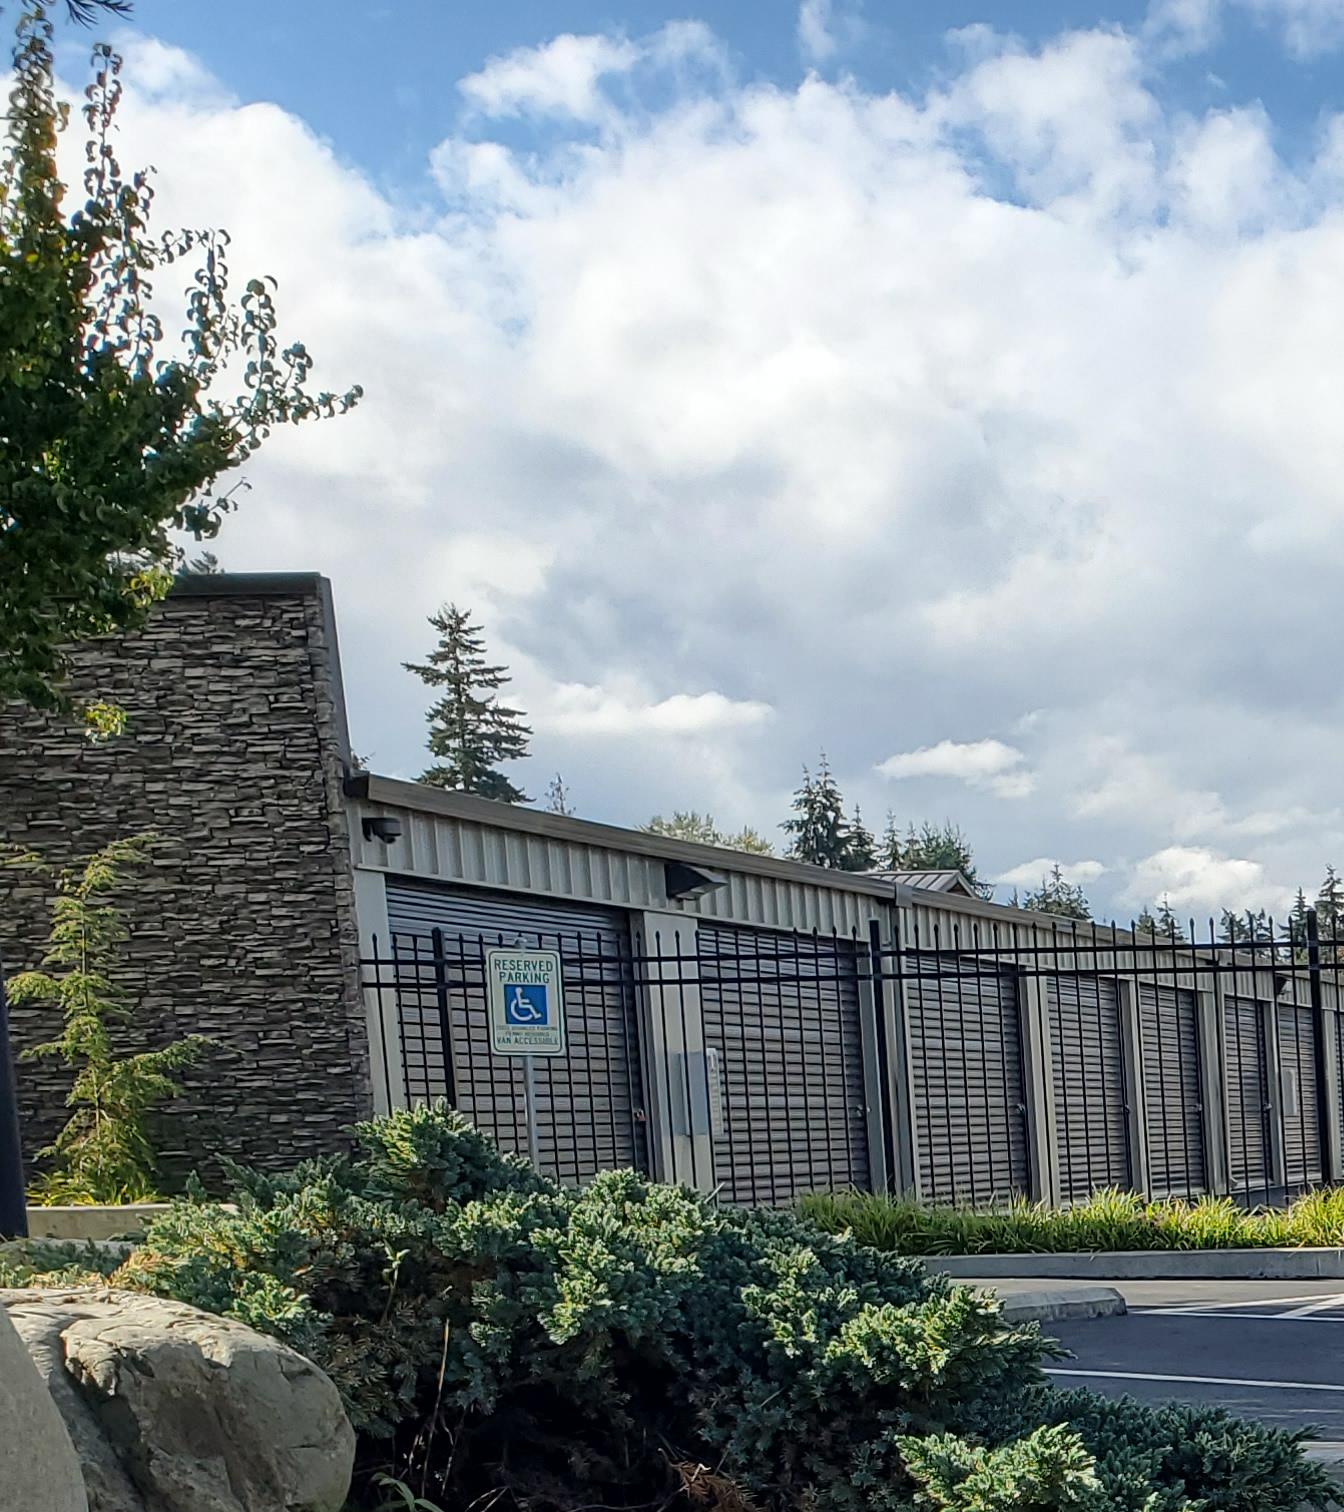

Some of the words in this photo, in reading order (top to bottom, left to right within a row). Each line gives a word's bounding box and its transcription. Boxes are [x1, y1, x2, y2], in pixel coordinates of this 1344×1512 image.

[494, 959, 554, 972] RESERVED
[499, 972, 550, 984] PARKING
[497, 1036, 512, 1045] VAN
